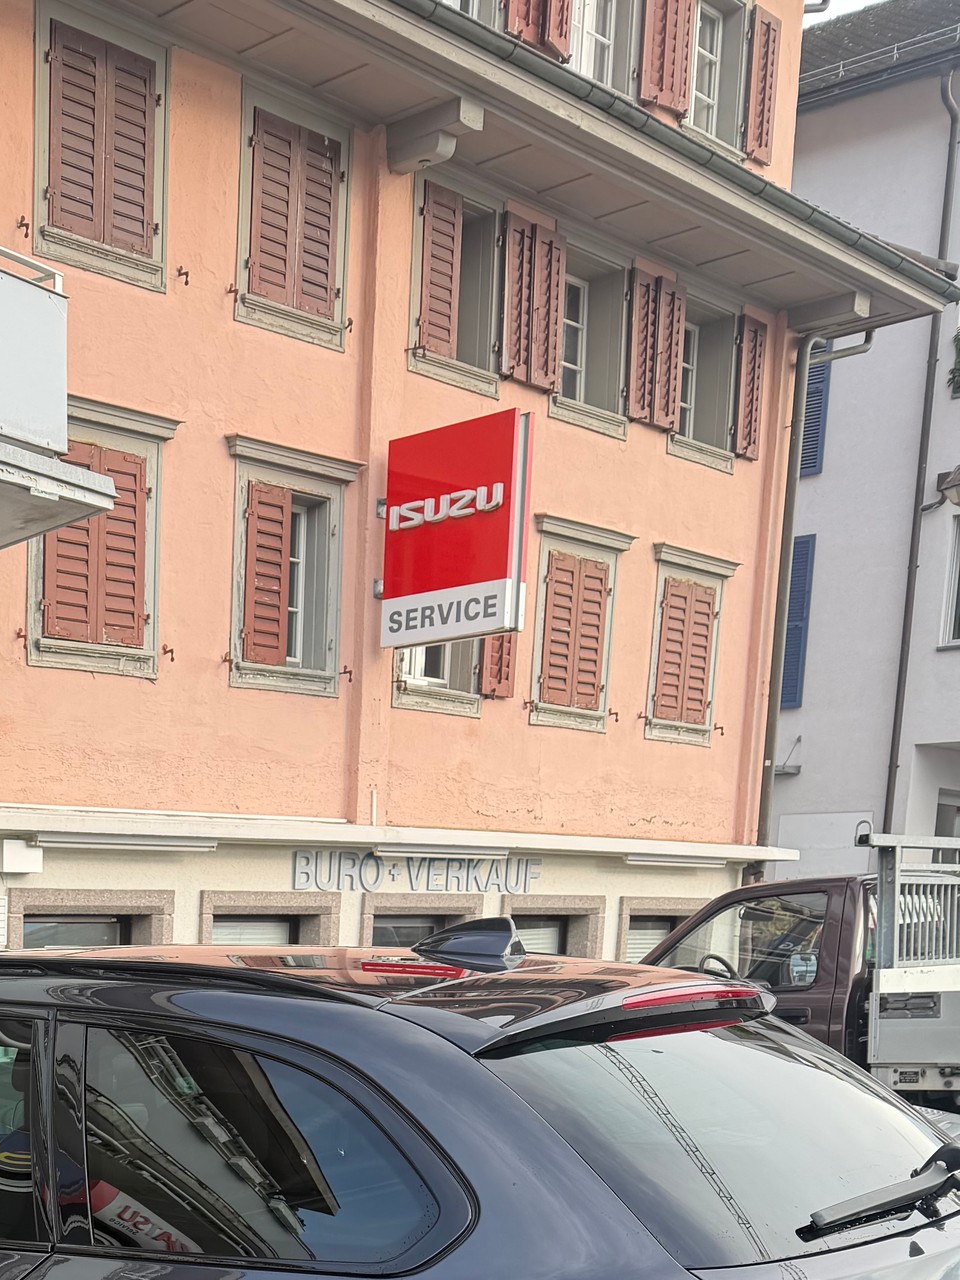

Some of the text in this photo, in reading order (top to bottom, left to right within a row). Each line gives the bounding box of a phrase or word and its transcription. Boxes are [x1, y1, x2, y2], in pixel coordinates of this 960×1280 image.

[389, 482, 505, 532] ISUZU
[388, 594, 498, 634] SERVICE
[405, 857, 543, 894] VERKAUF
